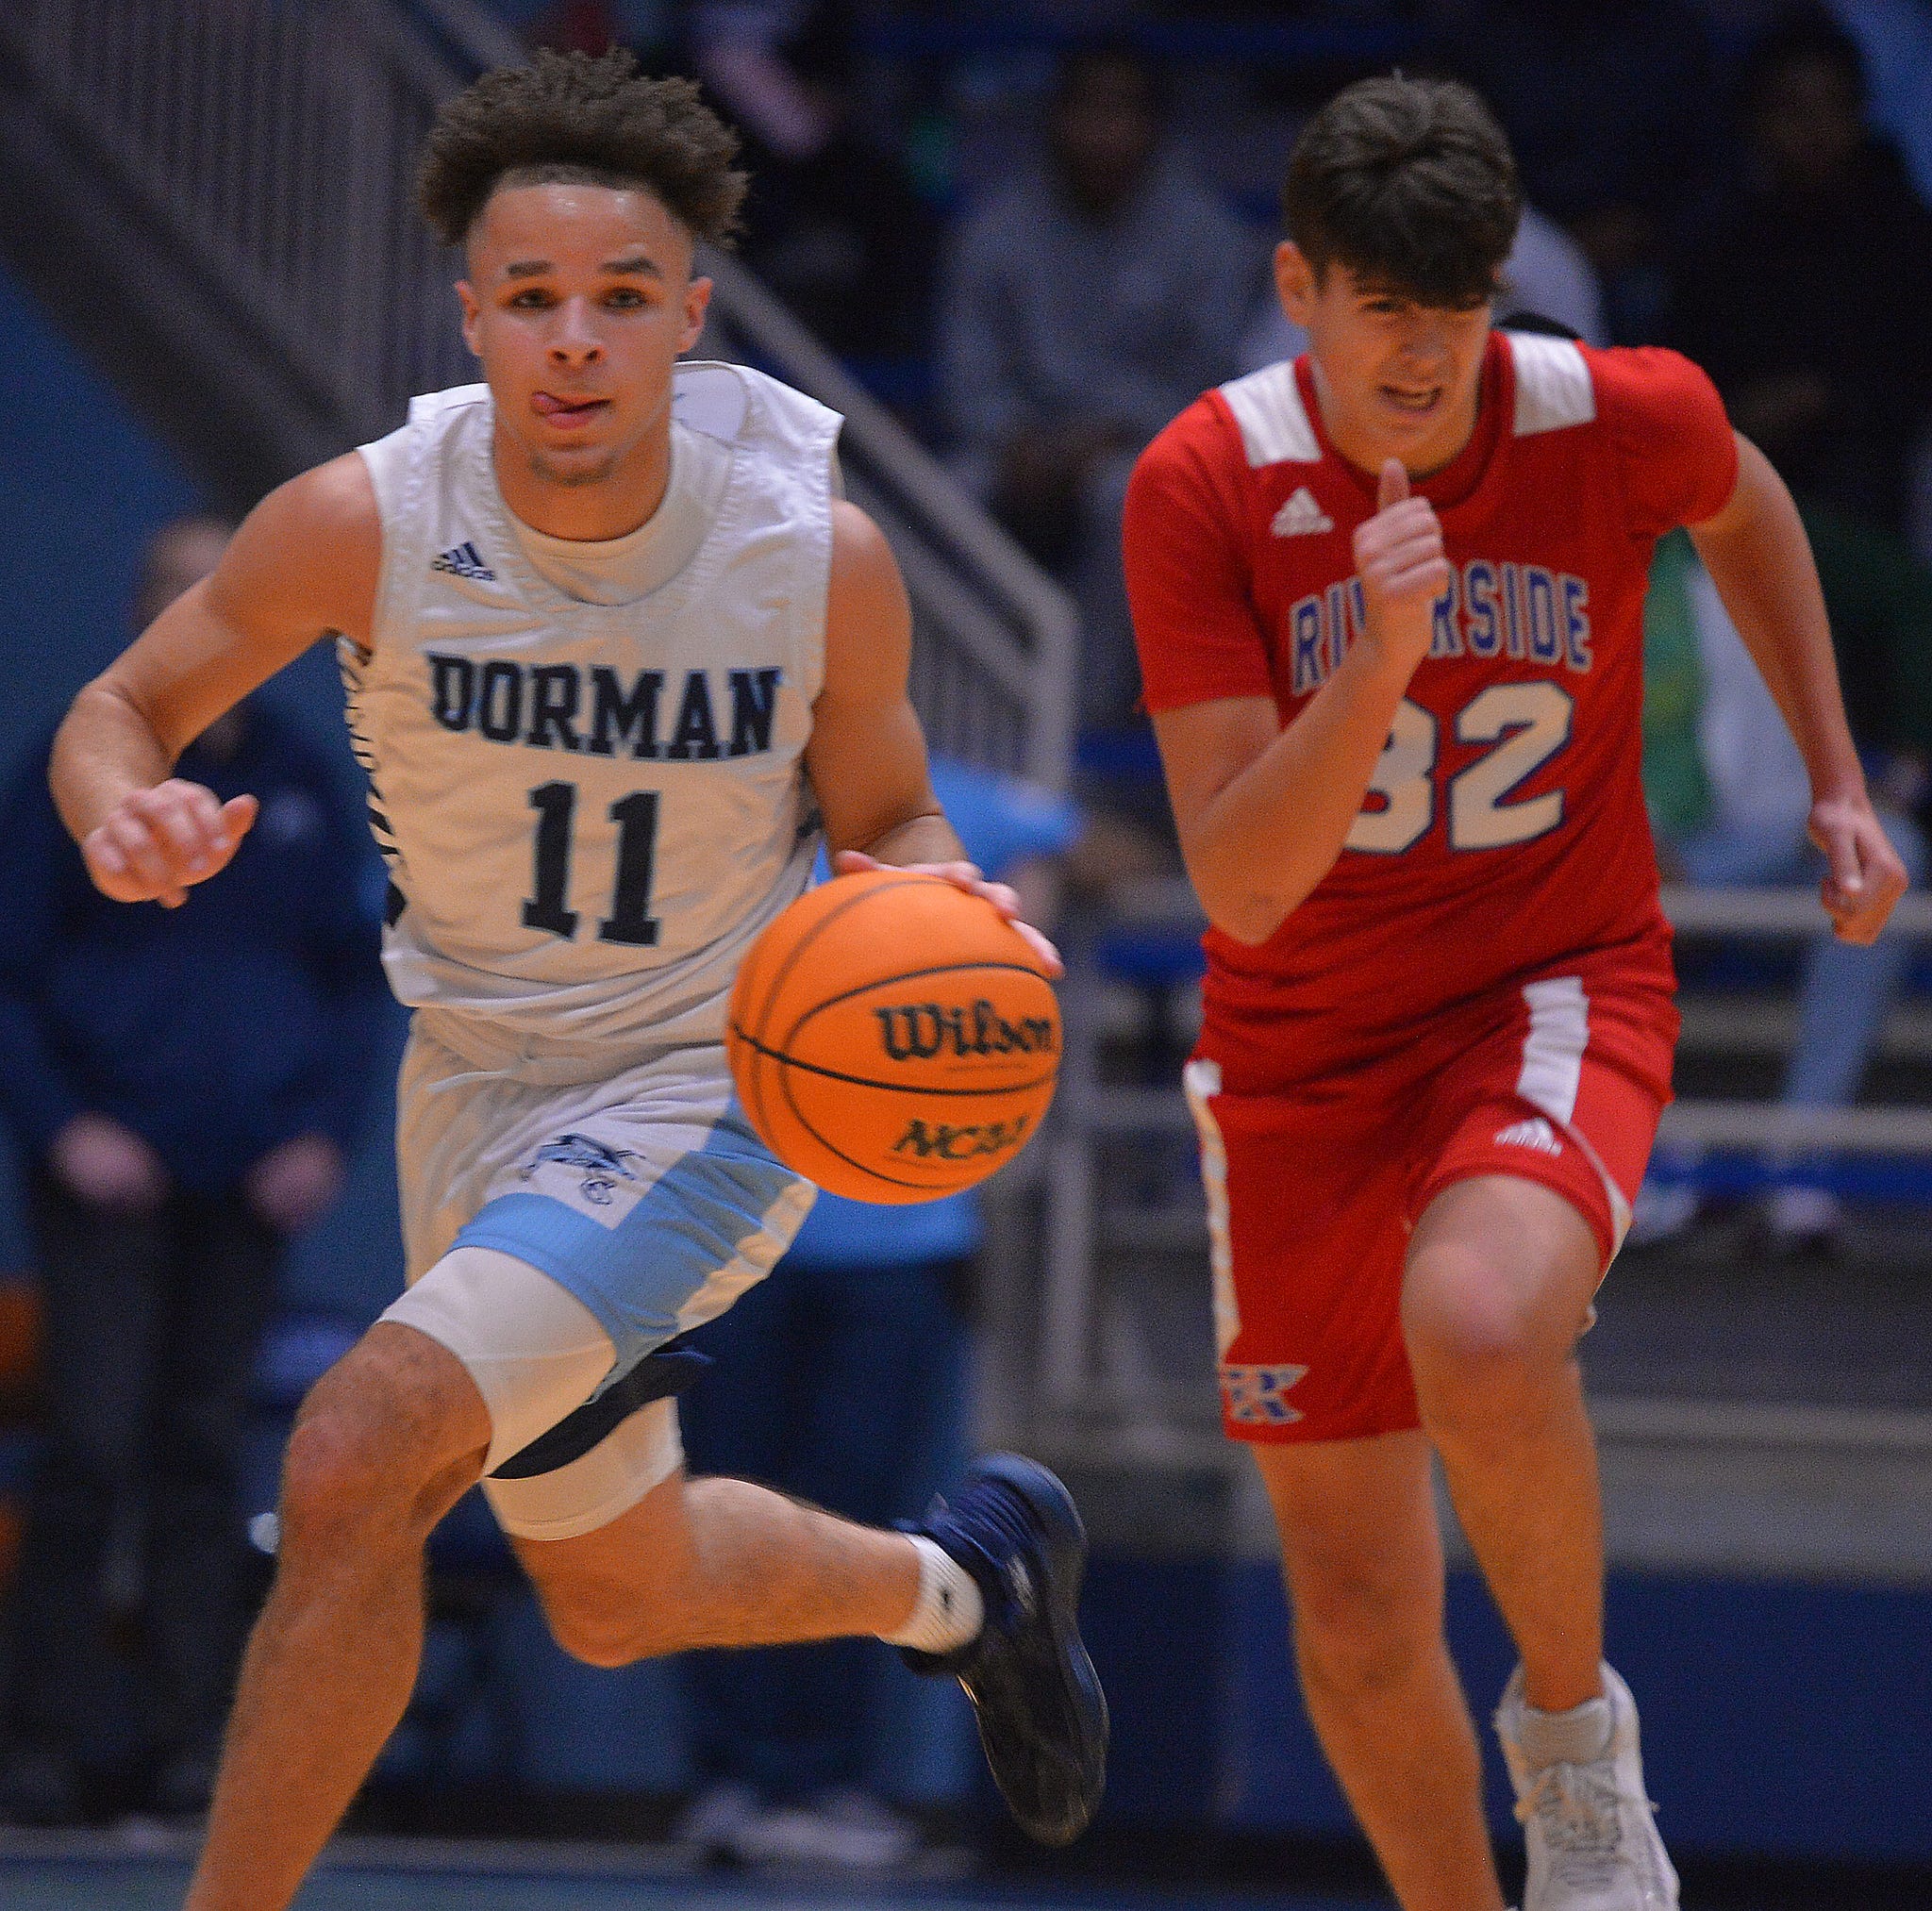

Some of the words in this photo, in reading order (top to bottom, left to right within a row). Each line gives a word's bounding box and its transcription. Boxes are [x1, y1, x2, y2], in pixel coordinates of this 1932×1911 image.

[1290, 559, 1593, 696] RIRSIDE
[426, 651, 784, 760] DORMAN
[521, 780, 661, 946] 11
[874, 999, 1054, 1061] Wilson
